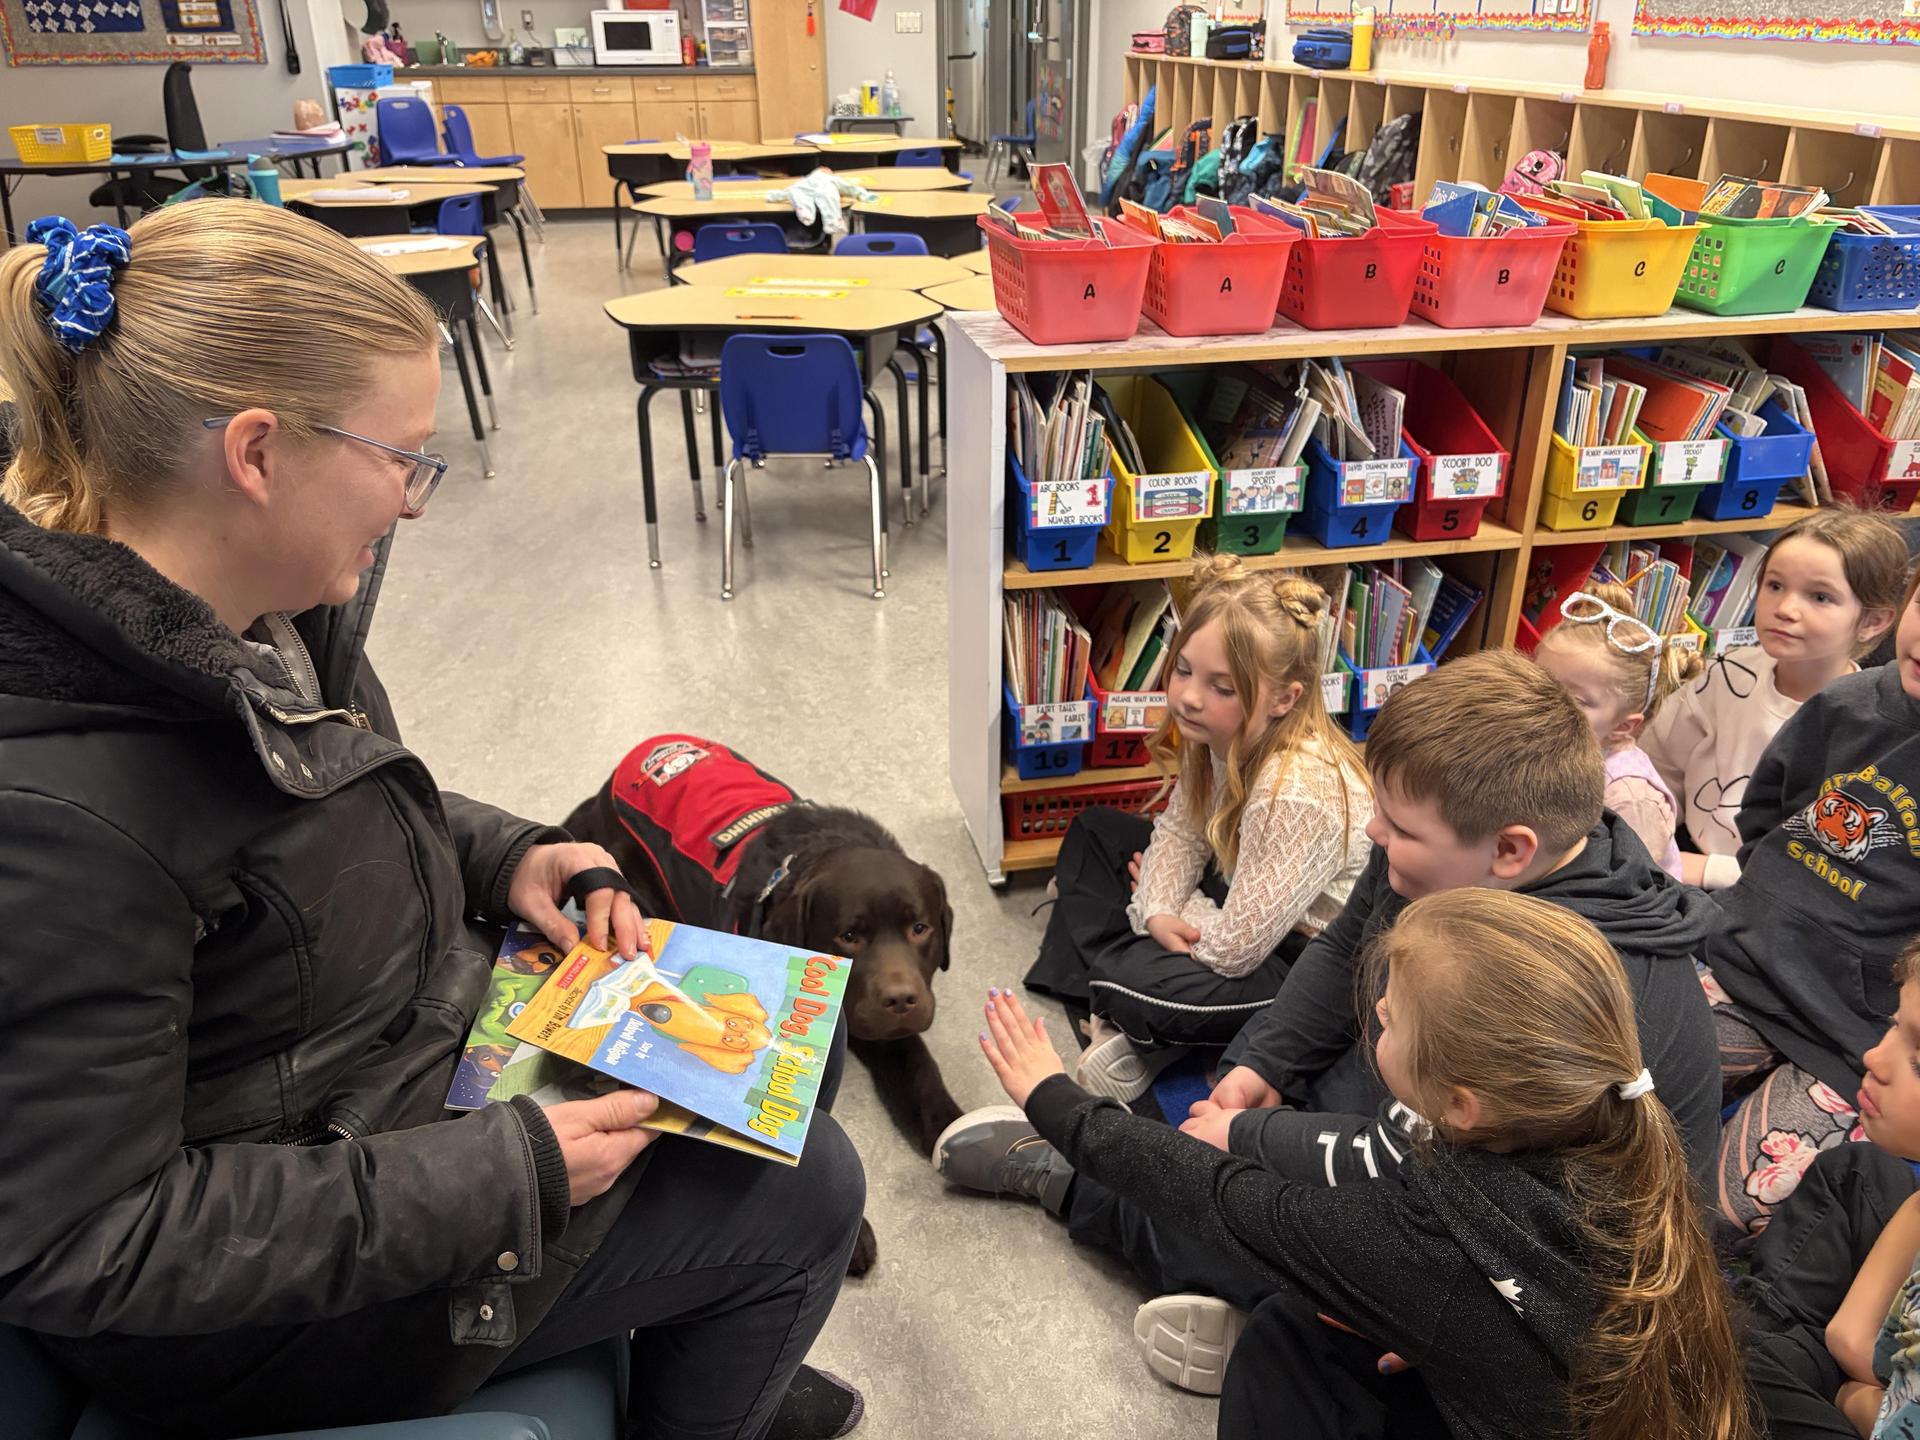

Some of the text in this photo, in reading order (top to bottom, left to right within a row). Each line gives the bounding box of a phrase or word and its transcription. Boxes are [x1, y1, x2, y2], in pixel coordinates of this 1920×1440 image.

[1365, 263, 1376, 279] B
[1497, 269, 1509, 284] B
[1634, 261, 1646, 277] C
[1775, 259, 1786, 275] C
[1084, 283, 1095, 299] A
[1220, 277, 1232, 292] A
[1442, 456, 1493, 469] SCOOBY DOO
[1055, 482, 1080, 492] BOOKS
[1148, 475, 1198, 487] COLOR BOOKS
[1251, 475, 1276, 485] SPORTS
[1087, 484, 1102, 506] 1
[1659, 495, 1675, 516] 7
[1741, 489, 1758, 511] 8
[1048, 514, 1103, 525] NUMBER BOOKS
[1442, 510, 1460, 531] 5
[1582, 499, 1598, 521] 6
[1243, 525, 1260, 547] 3
[1351, 516, 1368, 538] 4
[1054, 539, 1072, 562] 1
[1153, 531, 1170, 553] 2
[1322, 677, 1340, 686] OOKS
[1105, 738, 1140, 760] 17
[1034, 750, 1069, 771] 16
[1787, 839, 1868, 901] School
[800, 956, 838, 997] Cool
[748, 1041, 815, 1140] School Dog
